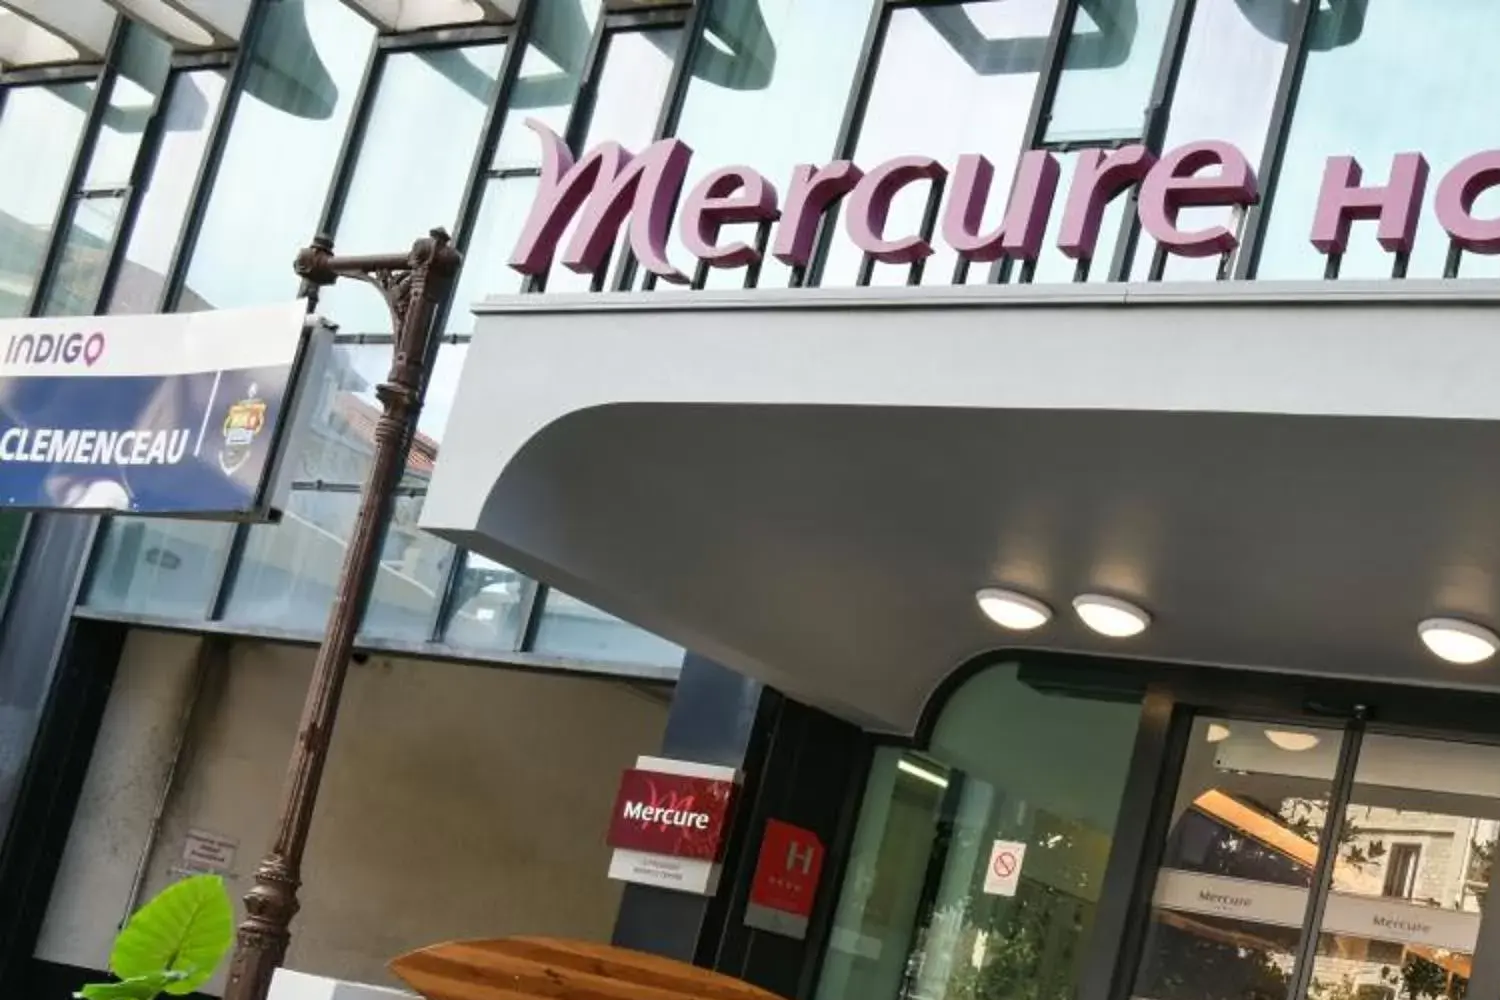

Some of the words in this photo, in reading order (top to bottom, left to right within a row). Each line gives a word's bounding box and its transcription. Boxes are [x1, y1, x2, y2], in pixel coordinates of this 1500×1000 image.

[508, 118, 1257, 284] Mercure
[3, 331, 106, 367] INDIGO
[0, 427, 190, 465] CLEMENCEAU
[622, 800, 710, 830] Mercure
[785, 840, 814, 875] H
[1372, 914, 1432, 934] Mercure
